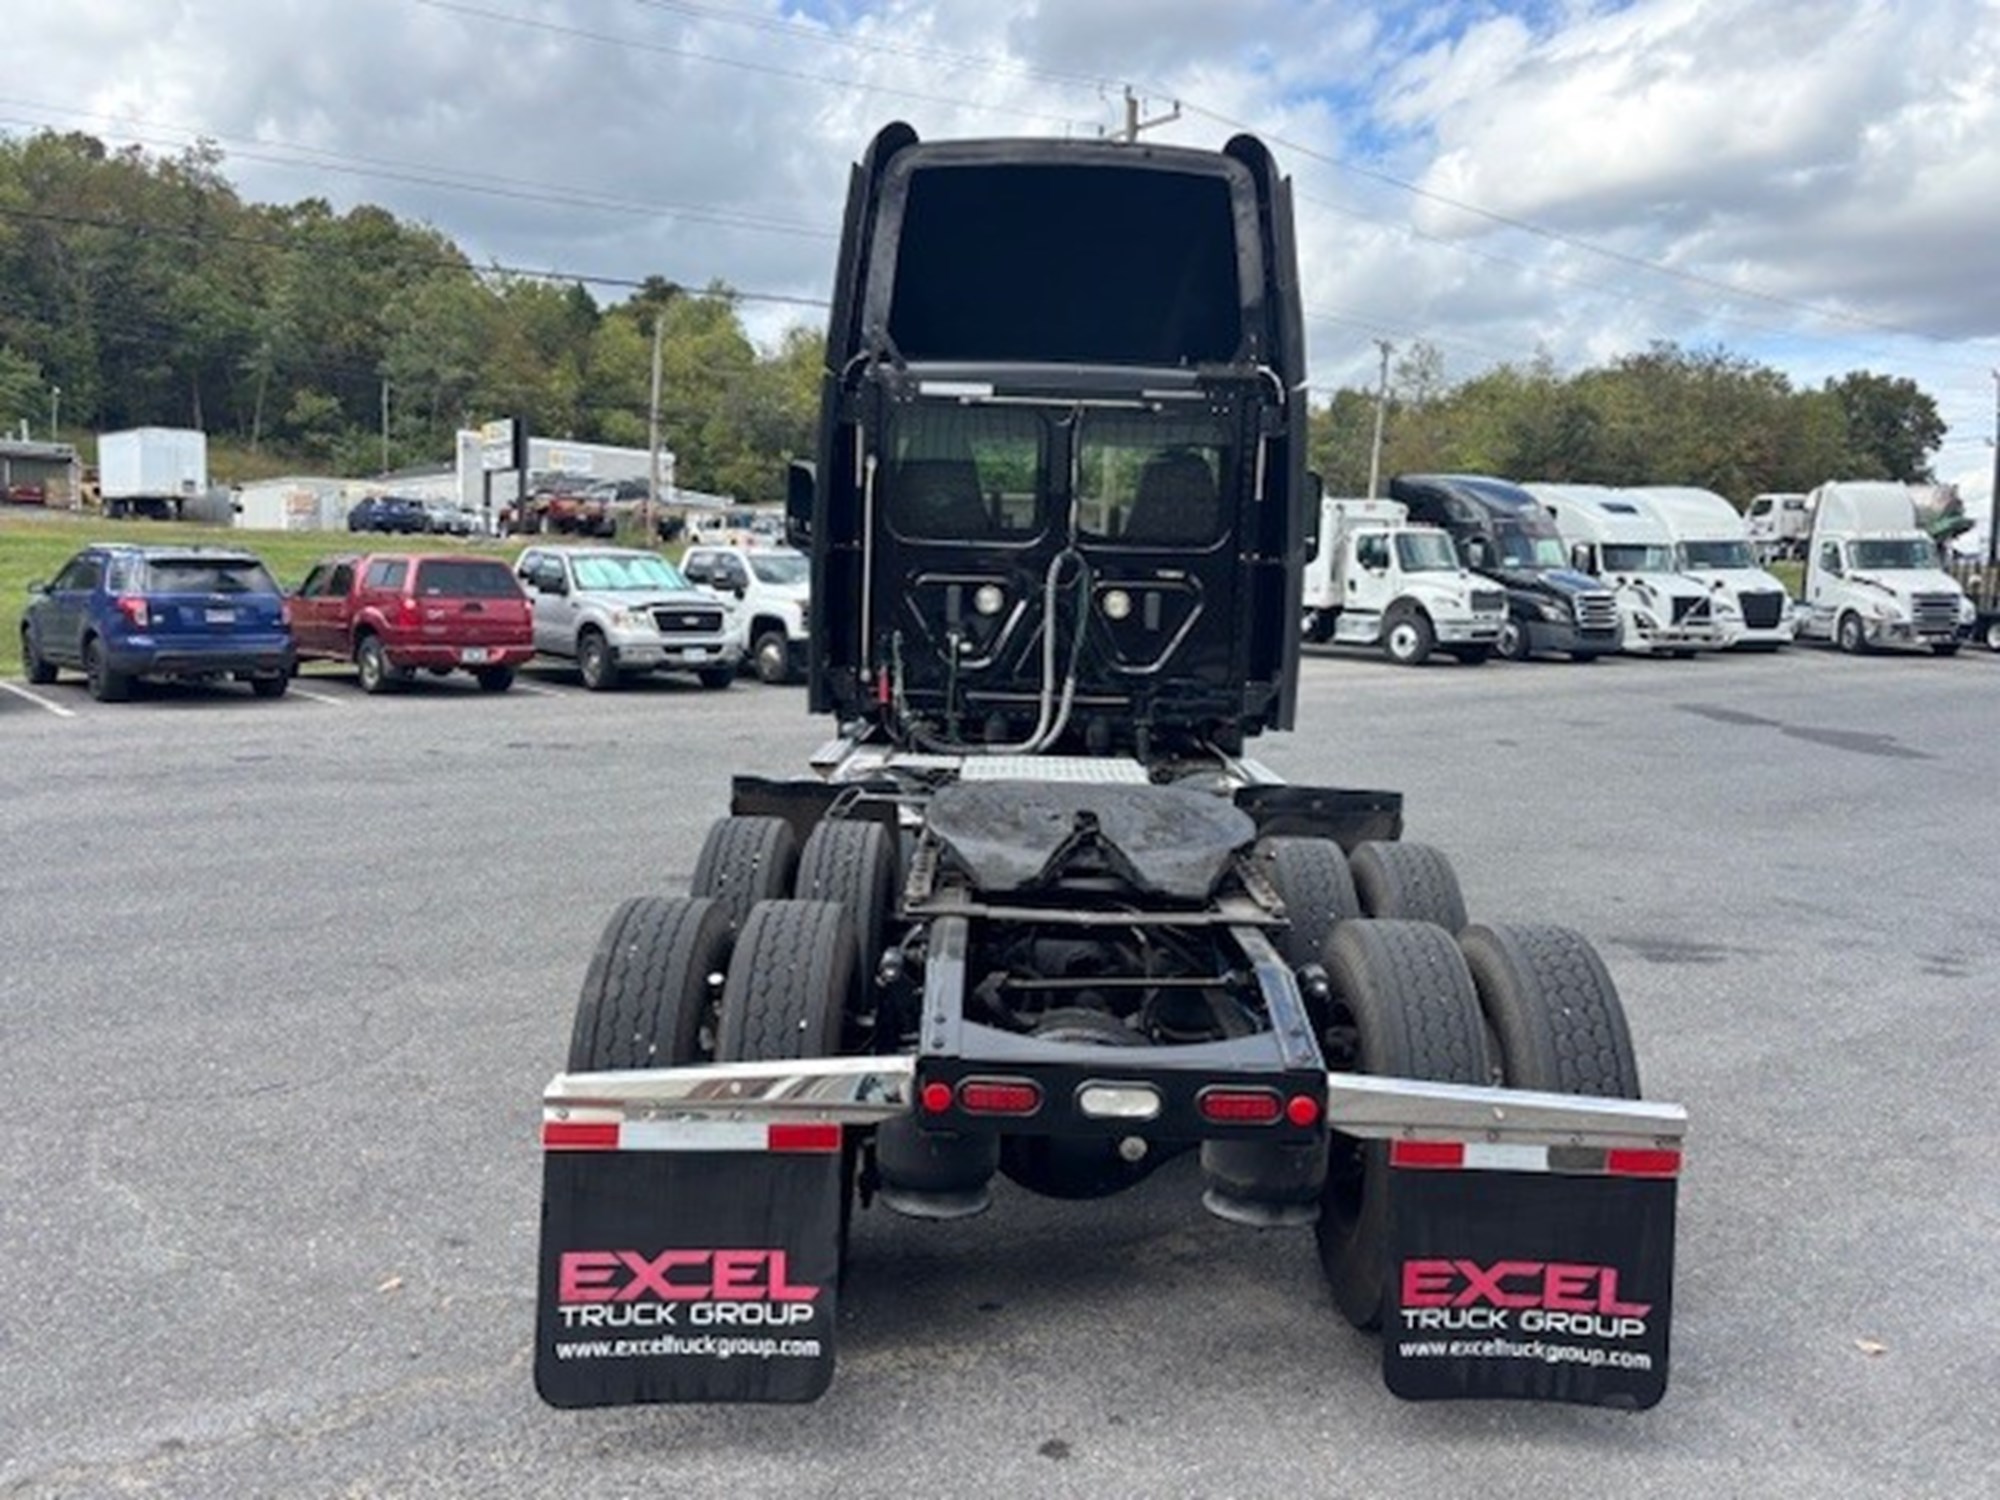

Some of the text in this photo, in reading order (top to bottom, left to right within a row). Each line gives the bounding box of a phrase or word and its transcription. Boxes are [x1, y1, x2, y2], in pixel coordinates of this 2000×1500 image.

[558, 1248, 820, 1303] EXCEL
[1400, 1258, 1652, 1318] EXCEL
[559, 1302, 815, 1328] TRUCK GROUP
[1401, 1307, 1647, 1338] TRUCK GROUP
[555, 1333, 821, 1361] www.exceltruckgroup.com
[1398, 1337, 1652, 1371] www.exceltruckgroup.com
